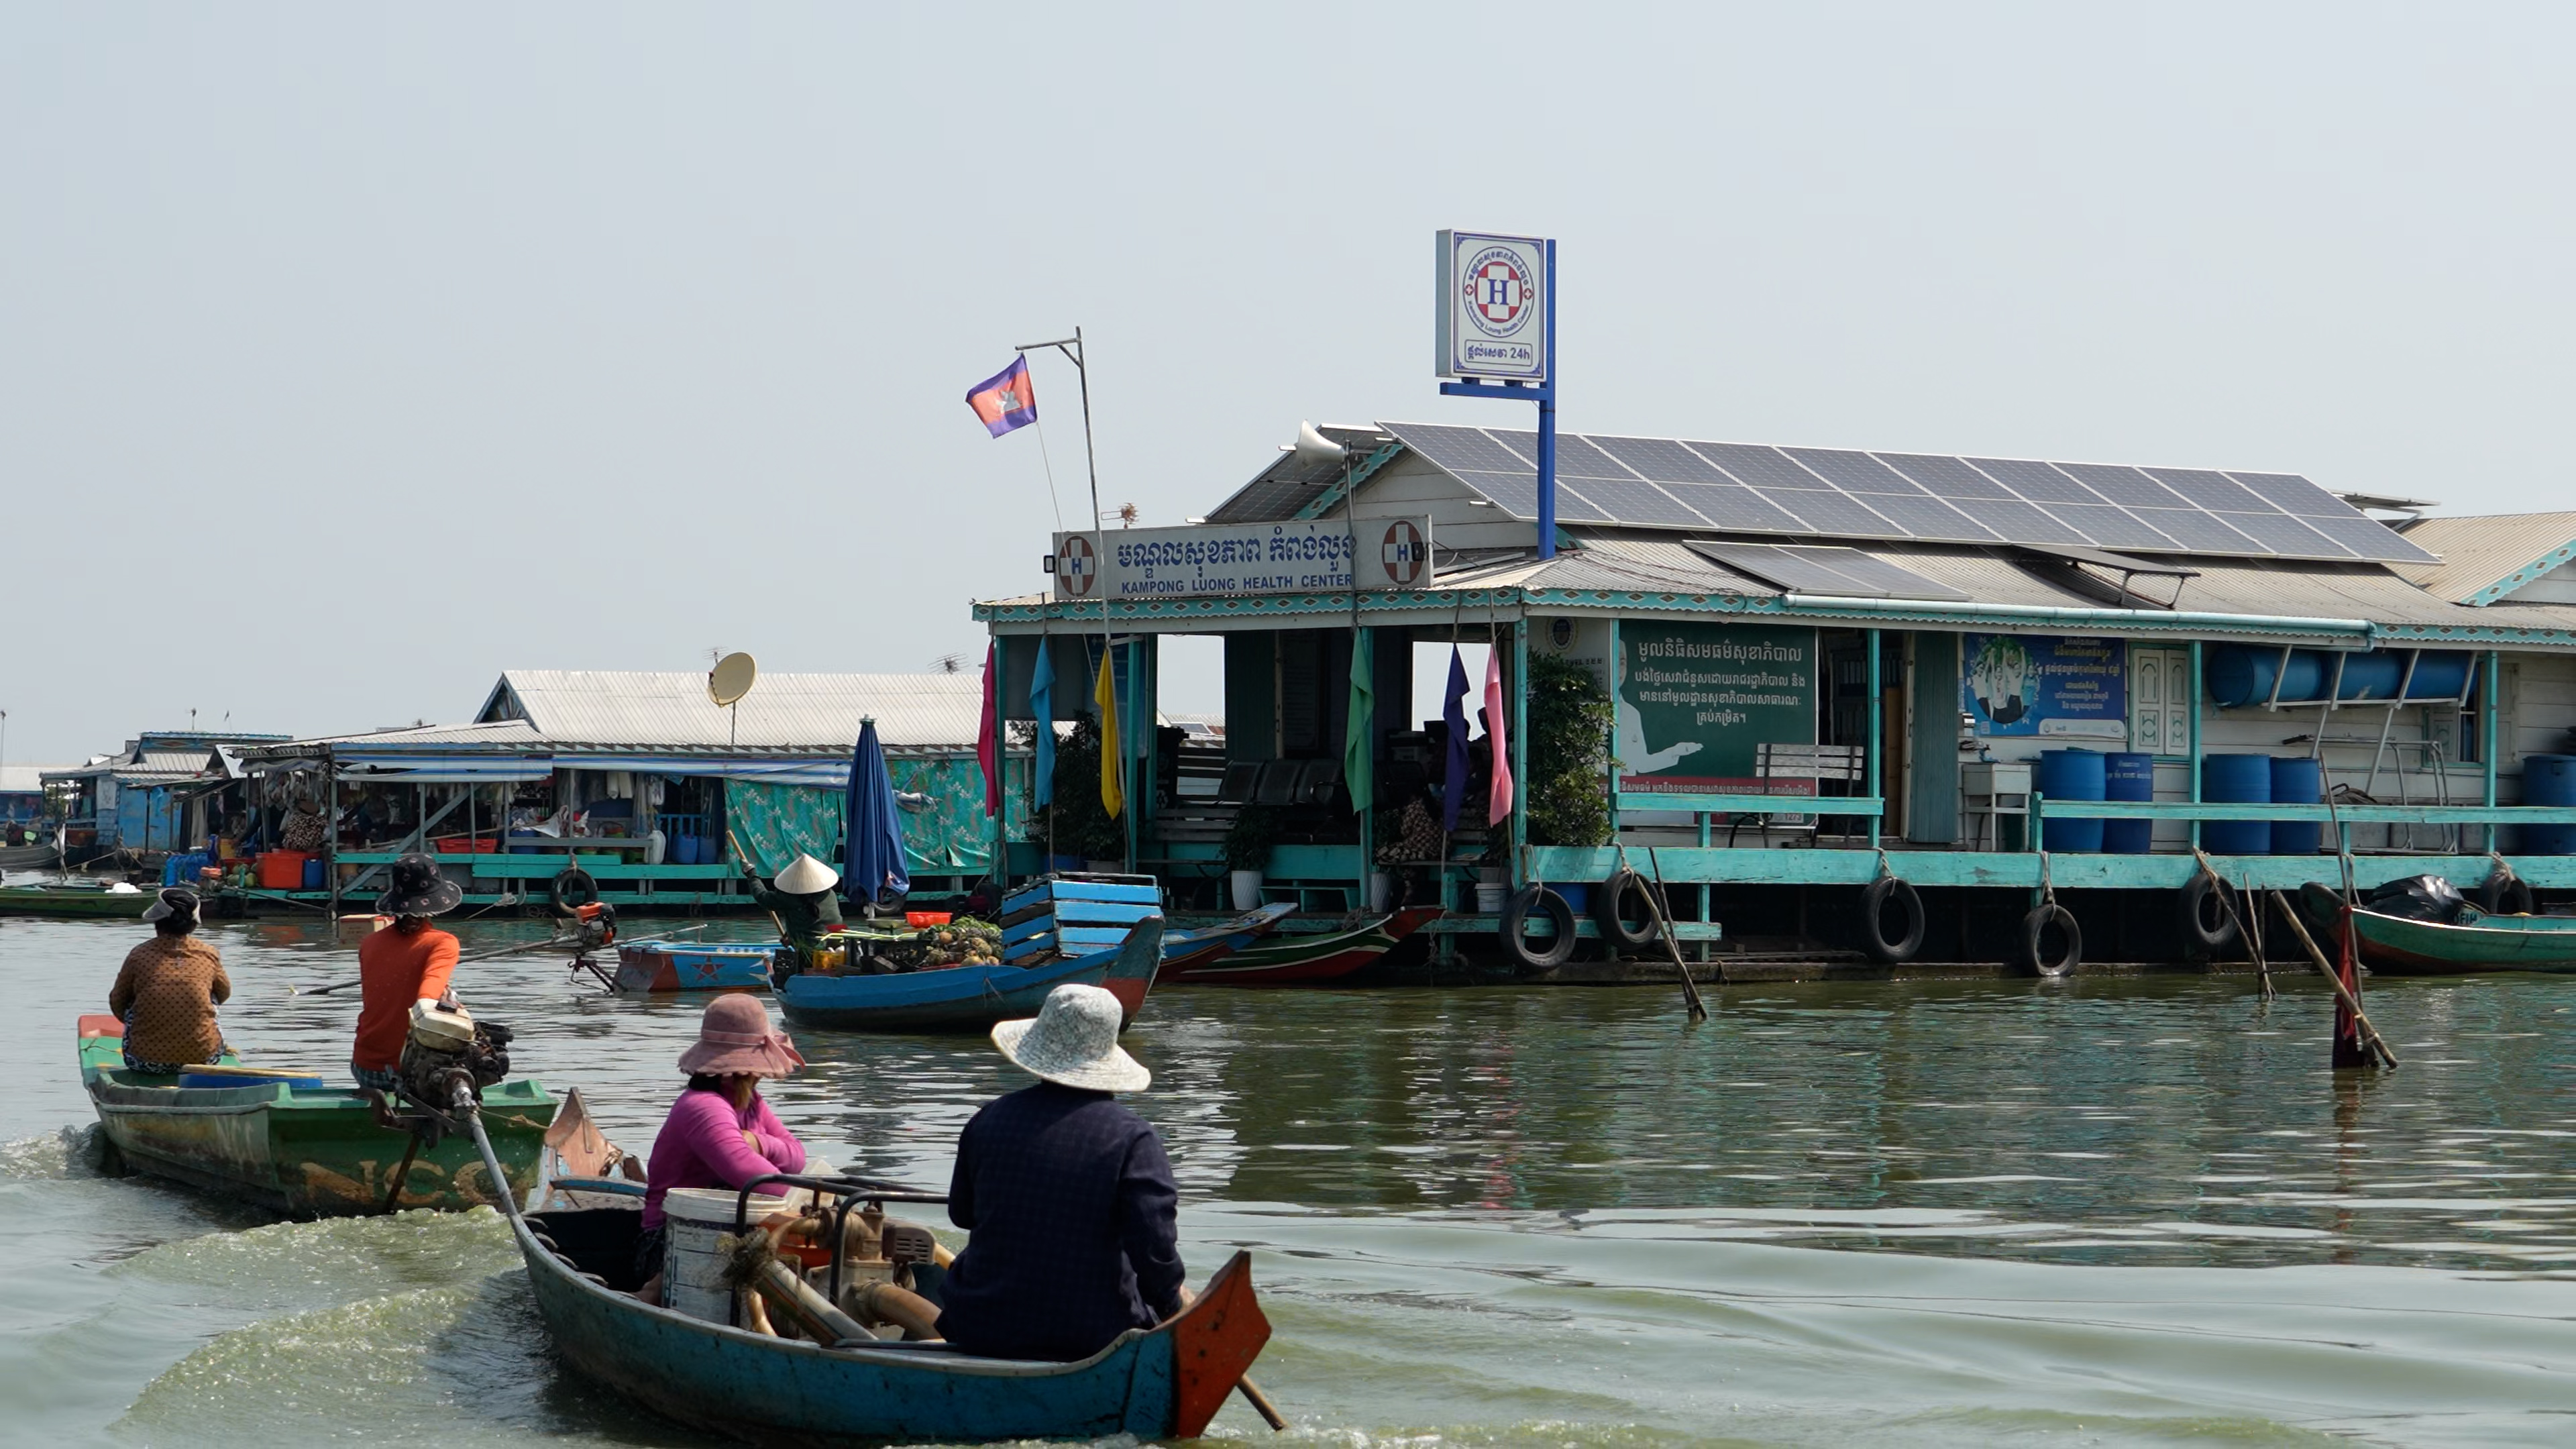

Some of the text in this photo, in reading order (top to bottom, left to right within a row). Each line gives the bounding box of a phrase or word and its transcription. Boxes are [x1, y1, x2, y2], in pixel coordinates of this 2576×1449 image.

[1488, 279, 1509, 305] H
[1510, 347, 1530, 360] 24h
[1072, 557, 1082, 575] H
[1121, 574, 1352, 594] KAMPONG LUONG HEALTH CENTER
